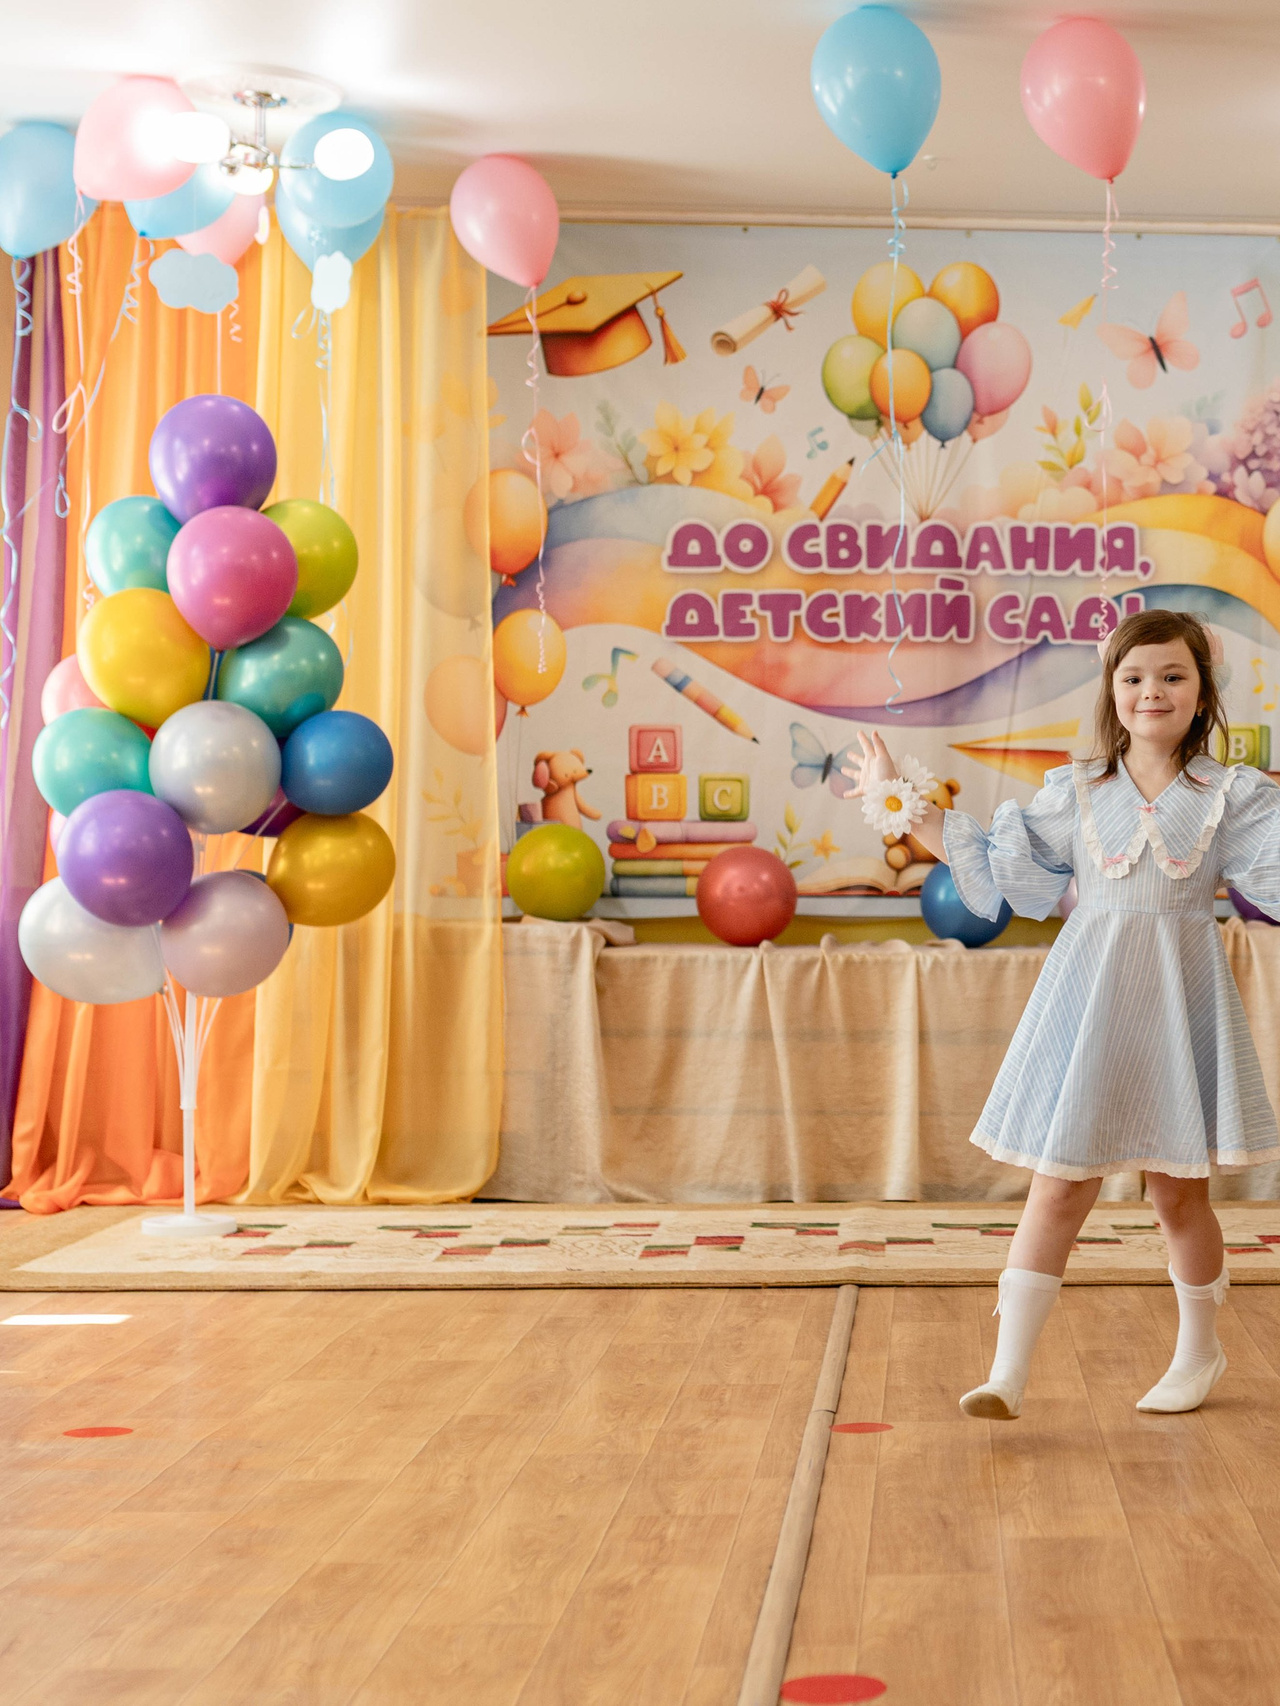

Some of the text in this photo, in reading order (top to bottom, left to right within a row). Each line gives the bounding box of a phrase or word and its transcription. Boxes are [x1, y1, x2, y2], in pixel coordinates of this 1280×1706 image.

[664, 520, 1153, 579] ДО СВИДАНИЯ,
[663, 575, 973, 641] ДЕТСКИЙ
[647, 737, 669, 763] A
[1229, 735, 1248, 760] B
[650, 784, 669, 810] B
[713, 786, 732, 811] C
